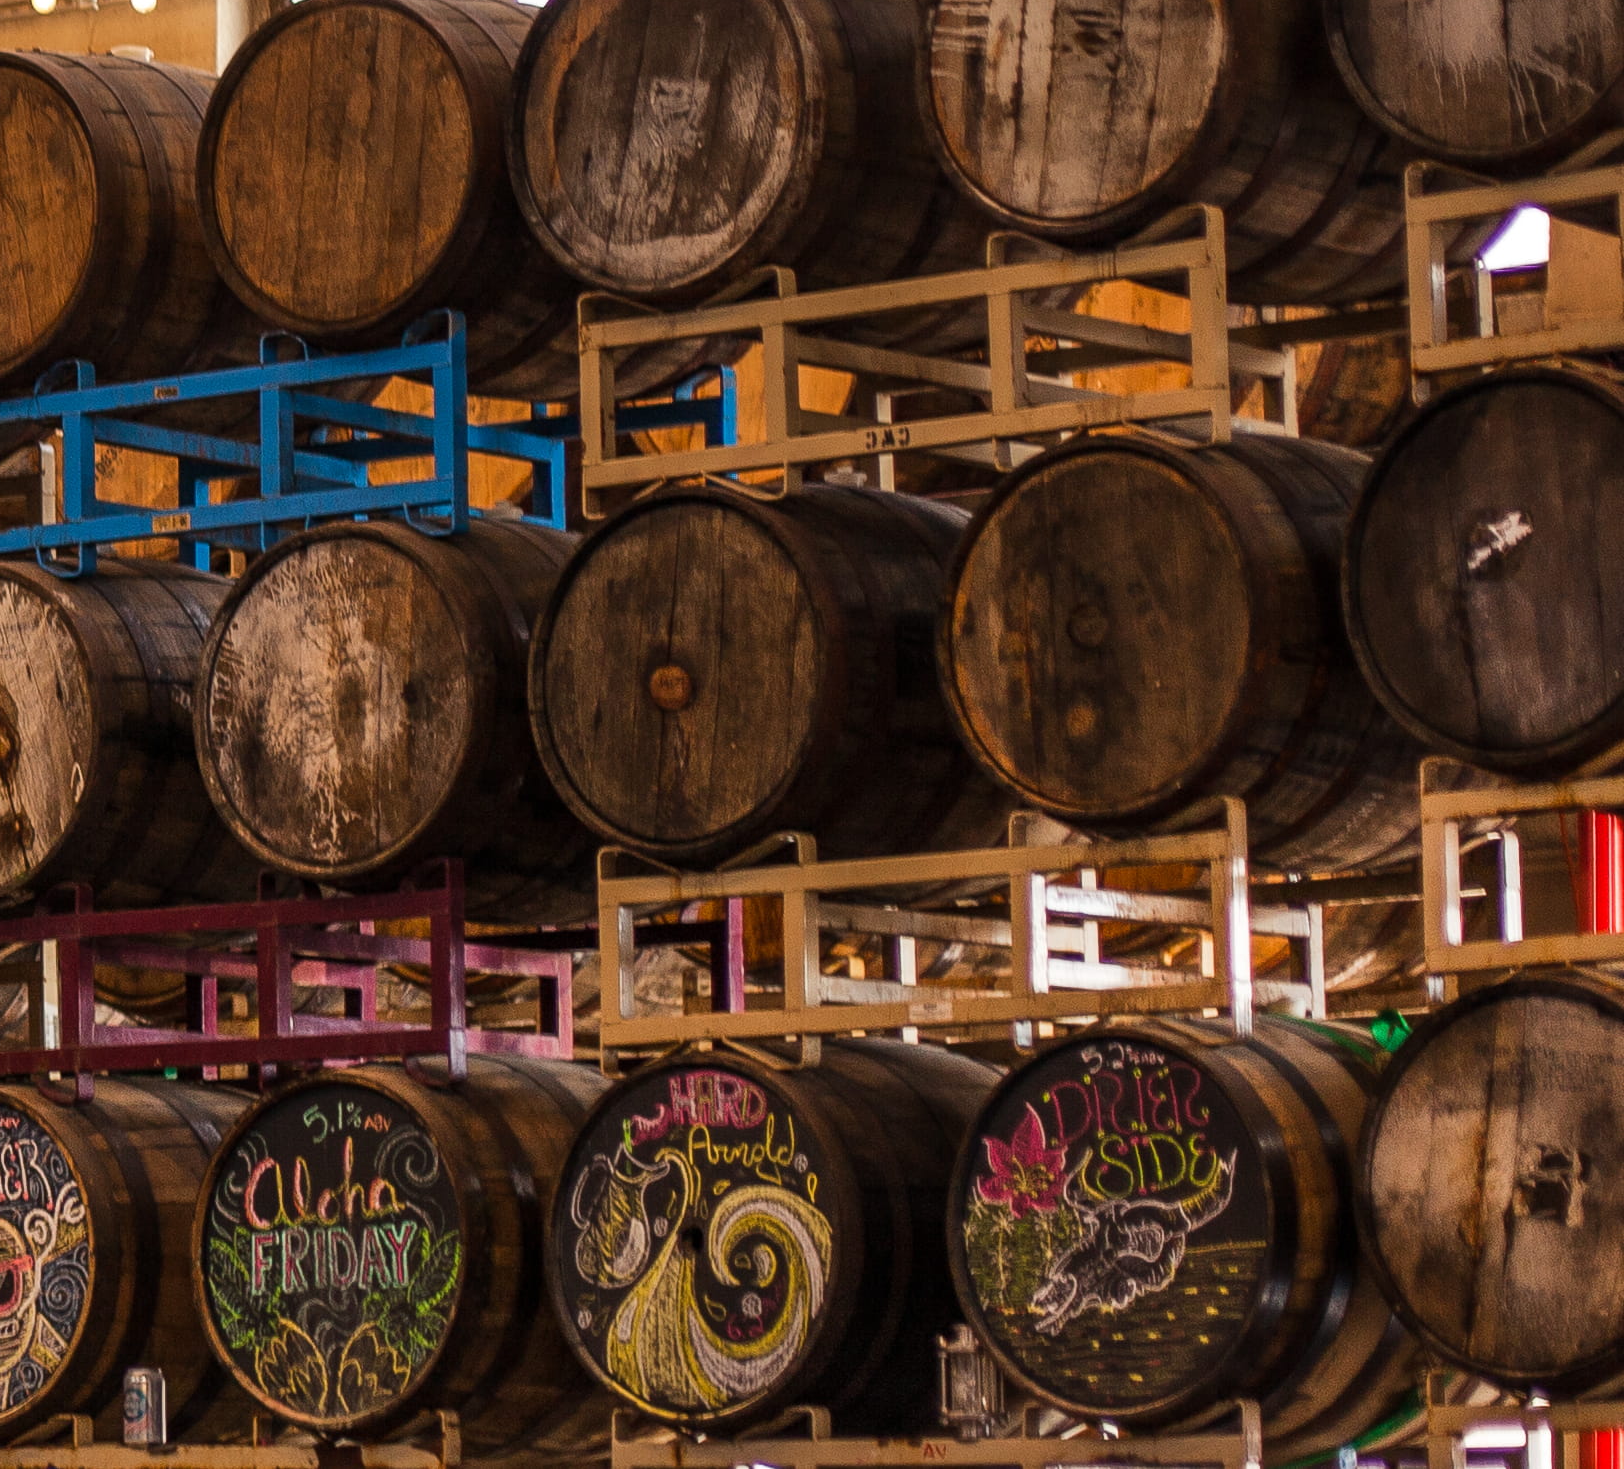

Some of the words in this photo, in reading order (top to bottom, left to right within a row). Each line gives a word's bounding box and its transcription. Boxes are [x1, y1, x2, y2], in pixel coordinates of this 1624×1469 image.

[303, 1101, 362, 1144] 5.1%
[670, 1069, 767, 1129] HARD
[688, 1112, 795, 1168] Arnold
[1096, 1132, 1218, 1198] SIDE
[251, 1220, 418, 1297] FRIDAY
